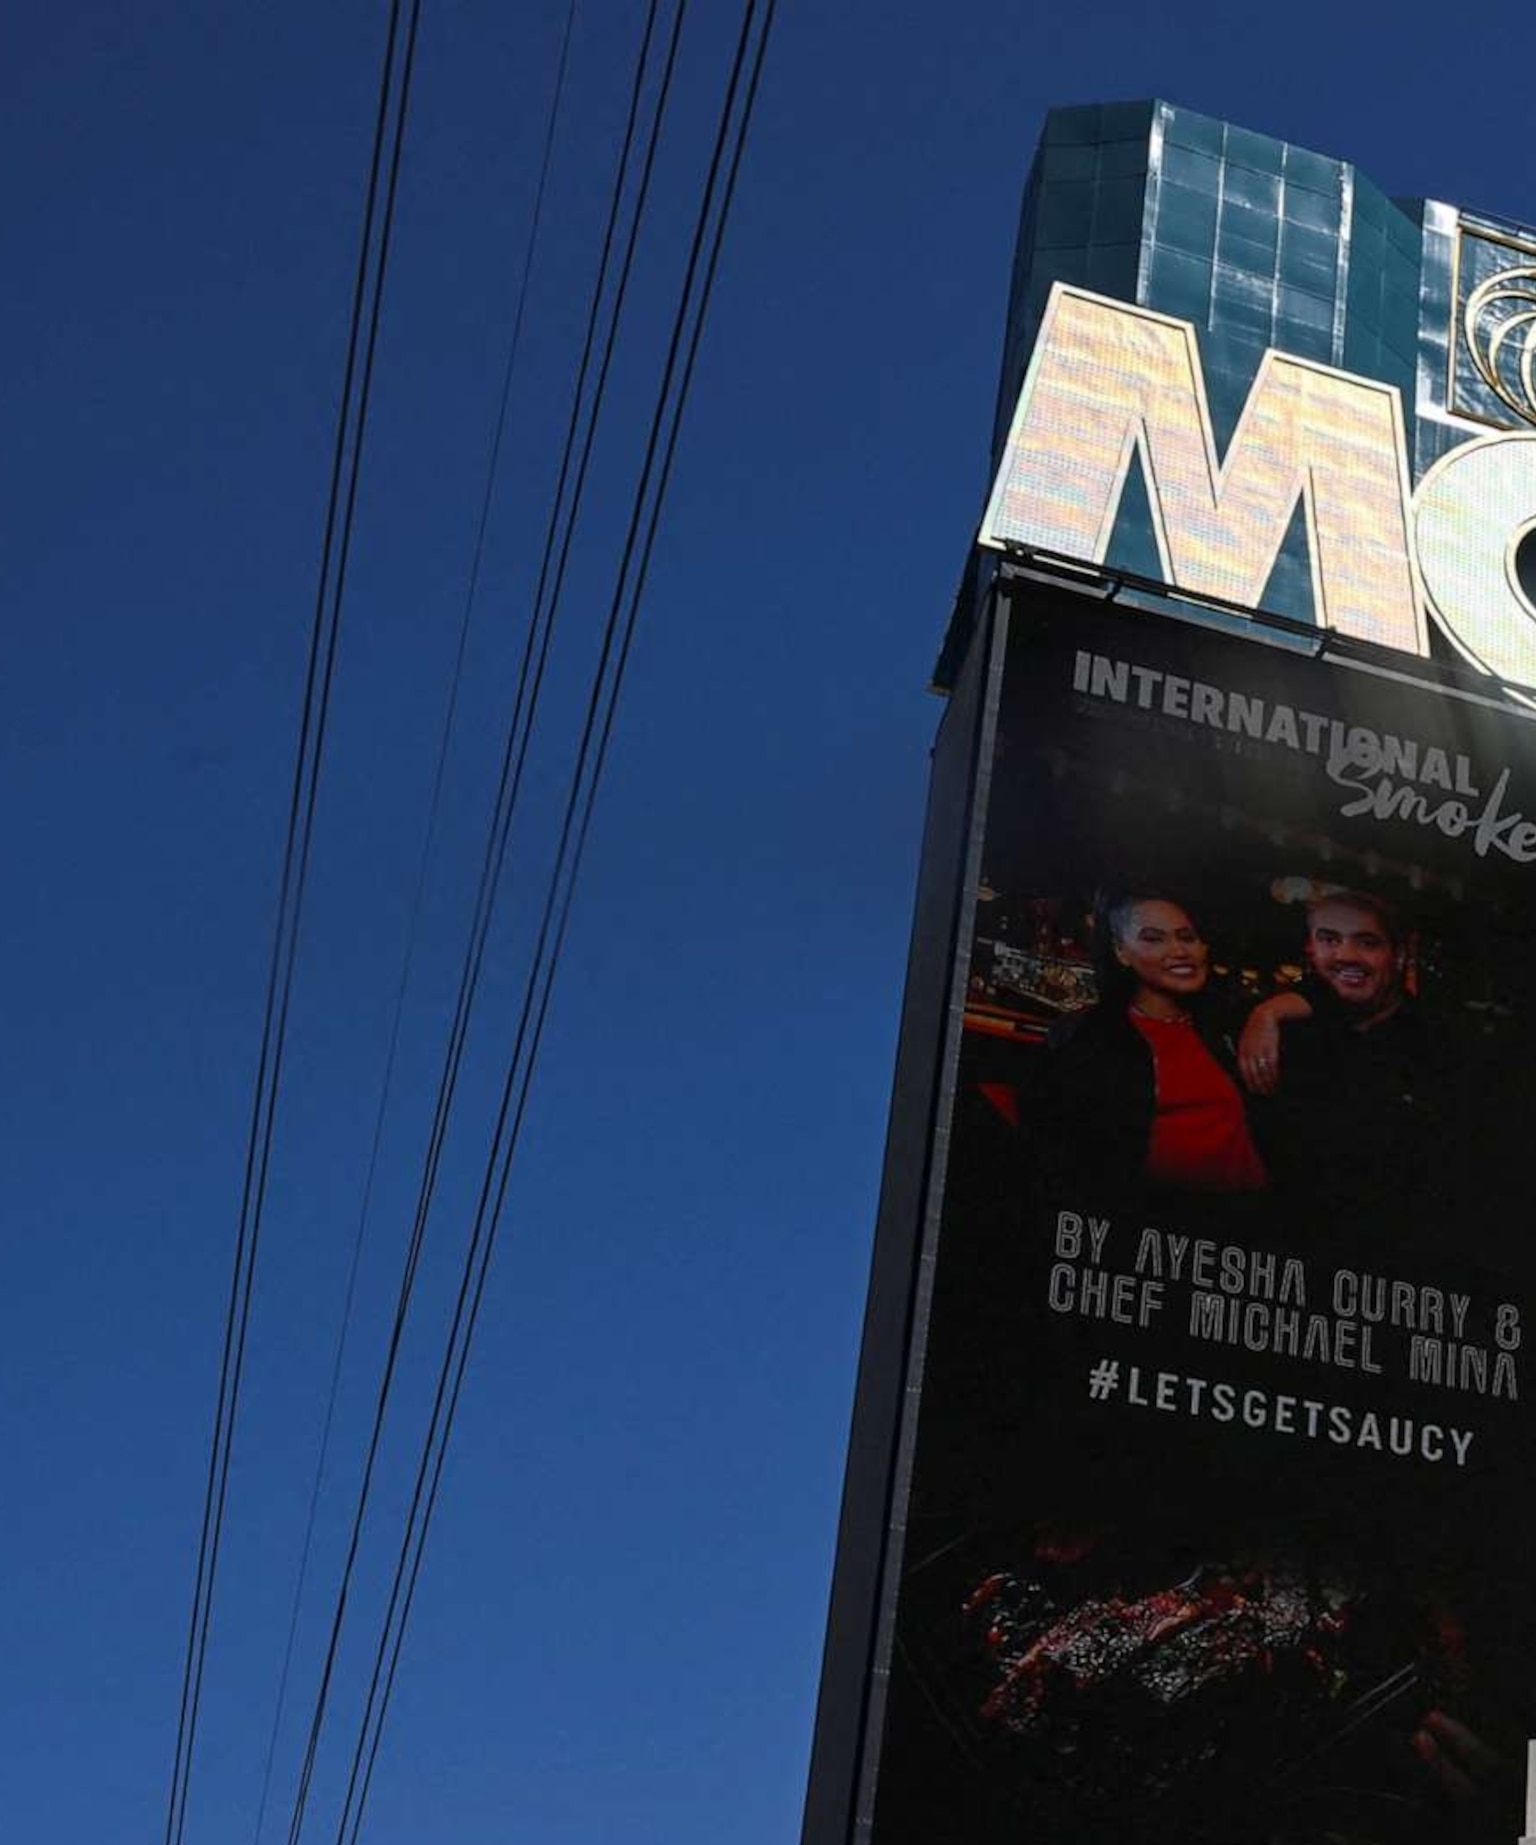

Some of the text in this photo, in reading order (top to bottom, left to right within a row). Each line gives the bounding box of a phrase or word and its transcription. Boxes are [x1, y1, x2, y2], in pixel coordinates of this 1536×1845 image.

[1073, 650, 1478, 798] INTERNATIONAL
[1048, 1263, 1518, 1401] CHEF MICHAEL MINA
[1055, 1210, 1521, 1350] BY AYESHA CURRY &
[1089, 1359, 1474, 1466] #LETSGETSAUCY
